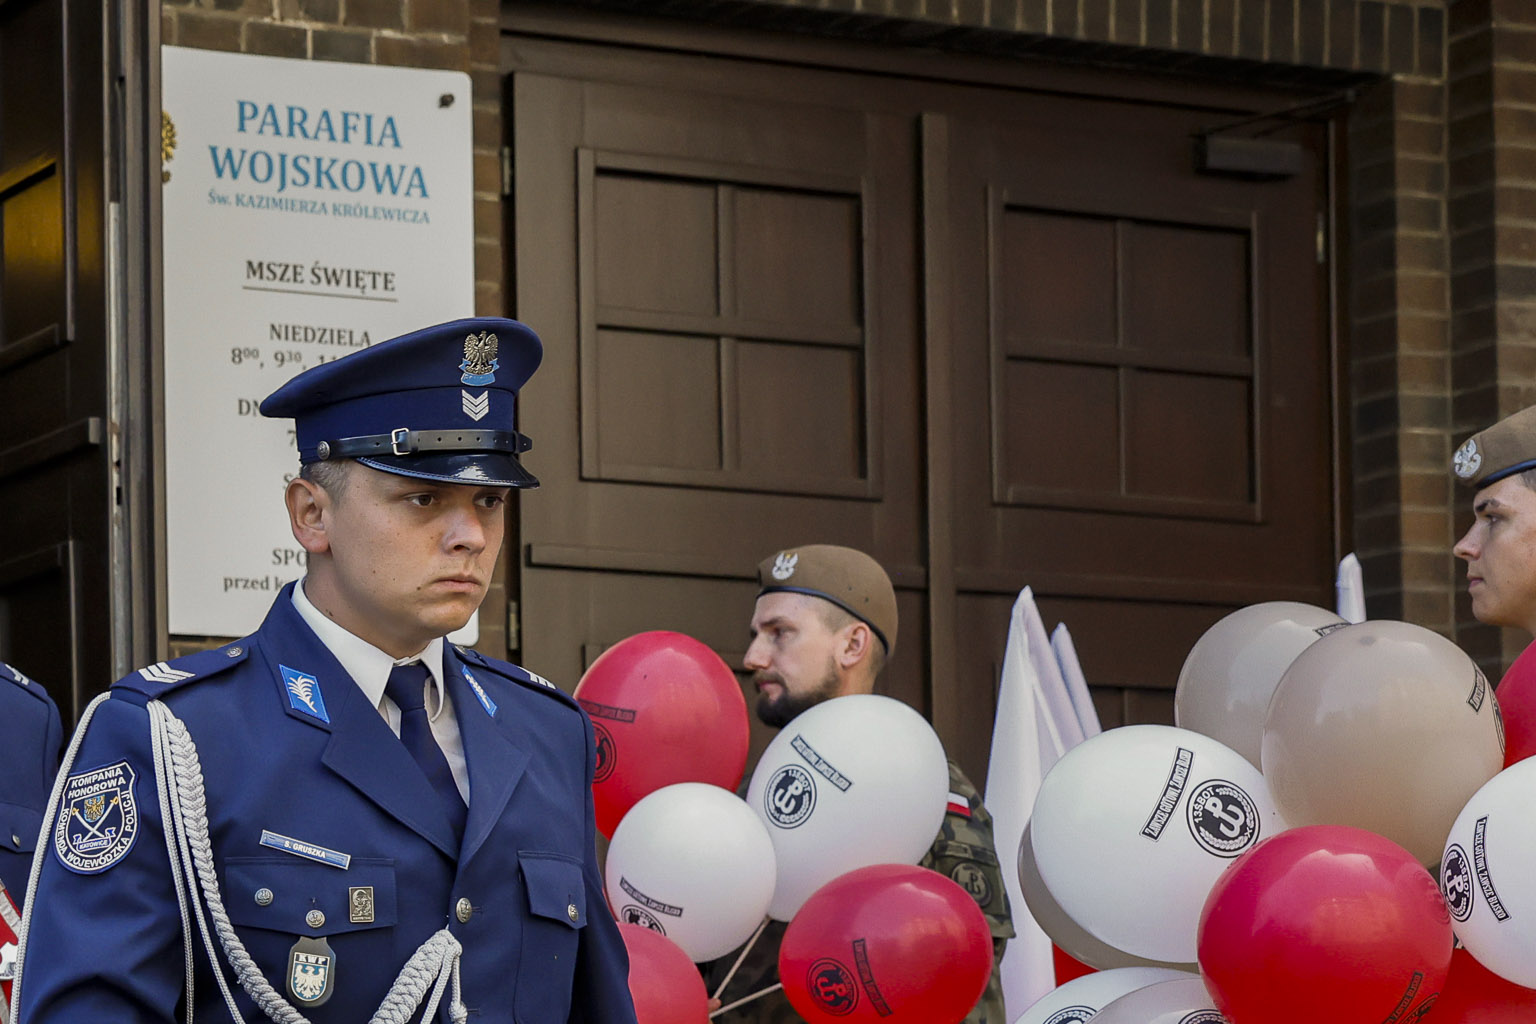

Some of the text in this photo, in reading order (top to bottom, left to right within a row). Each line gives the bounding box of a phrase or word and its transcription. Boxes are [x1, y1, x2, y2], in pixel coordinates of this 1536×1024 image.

[236, 100, 402, 148] PARAFIA
[208, 145, 429, 198] WOJSKOWA
[235, 193, 329, 216] KAZIMIERZA
[332, 201, 430, 224] KRÓLEWICZA
[245, 260, 396, 295] MSZE ŚWIĘTE
[270, 323, 371, 347] NIEDZIELA
[223, 576, 270, 593] przed
[67, 776, 126, 799] HONOROWA
[71, 767, 123, 789] KOMPANIA
[57, 790, 135, 868] KOMENDA WOJEWÓDZKA POLICJI
[284, 841, 326, 859] S. GRUSZKA
[298, 954, 328, 965] KWP
